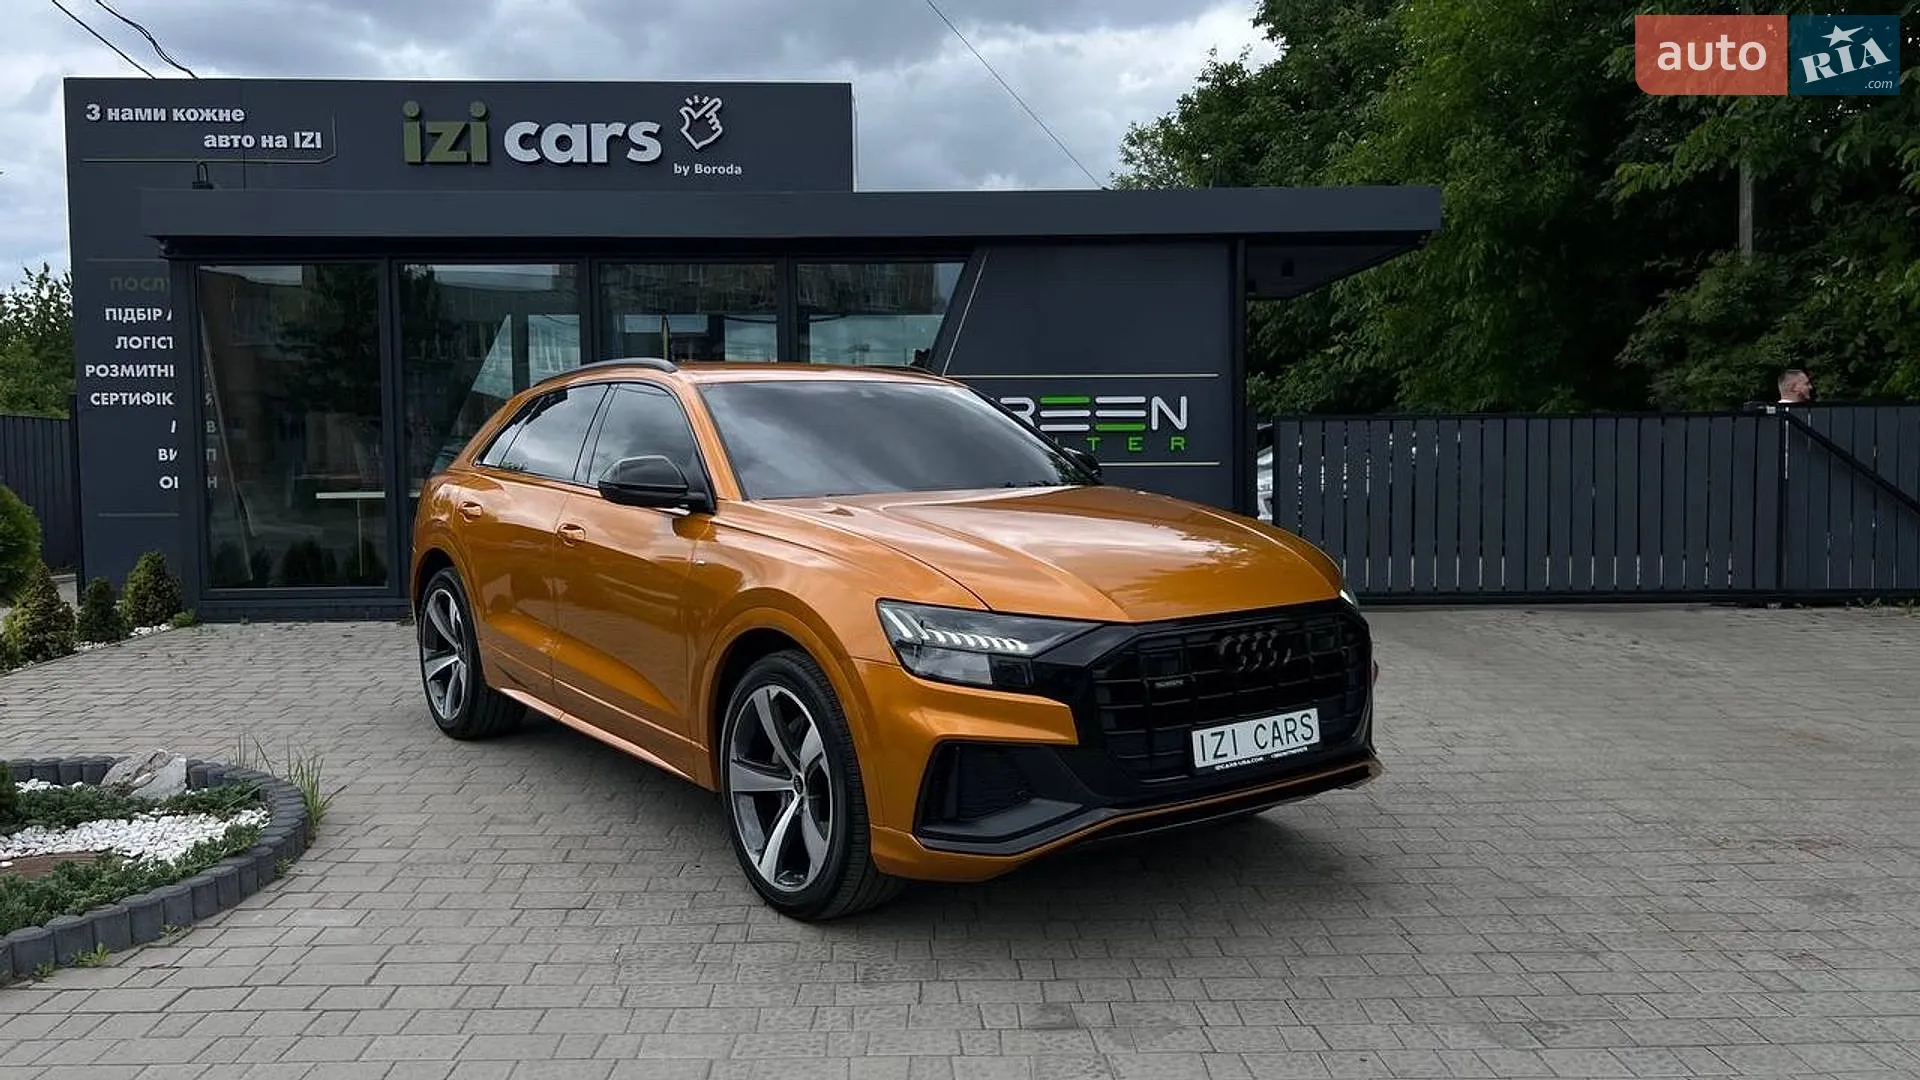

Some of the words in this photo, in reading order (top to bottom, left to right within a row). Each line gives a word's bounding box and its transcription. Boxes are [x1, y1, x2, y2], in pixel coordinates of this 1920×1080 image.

[107, 106, 167, 122] нами
[172, 106, 245, 122] кожне
[402, 100, 489, 163] izi
[503, 121, 662, 163] cars
[203, 133, 255, 149] авто
[261, 134, 287, 149] на
[673, 163, 690, 176] by
[694, 163, 743, 176] Boroda
[105, 307, 163, 324] ПІДБІР
[1000, 395, 1188, 432] REEN
[1200, 729, 1239, 761] IZI
[1253, 712, 1315, 750] CARS
